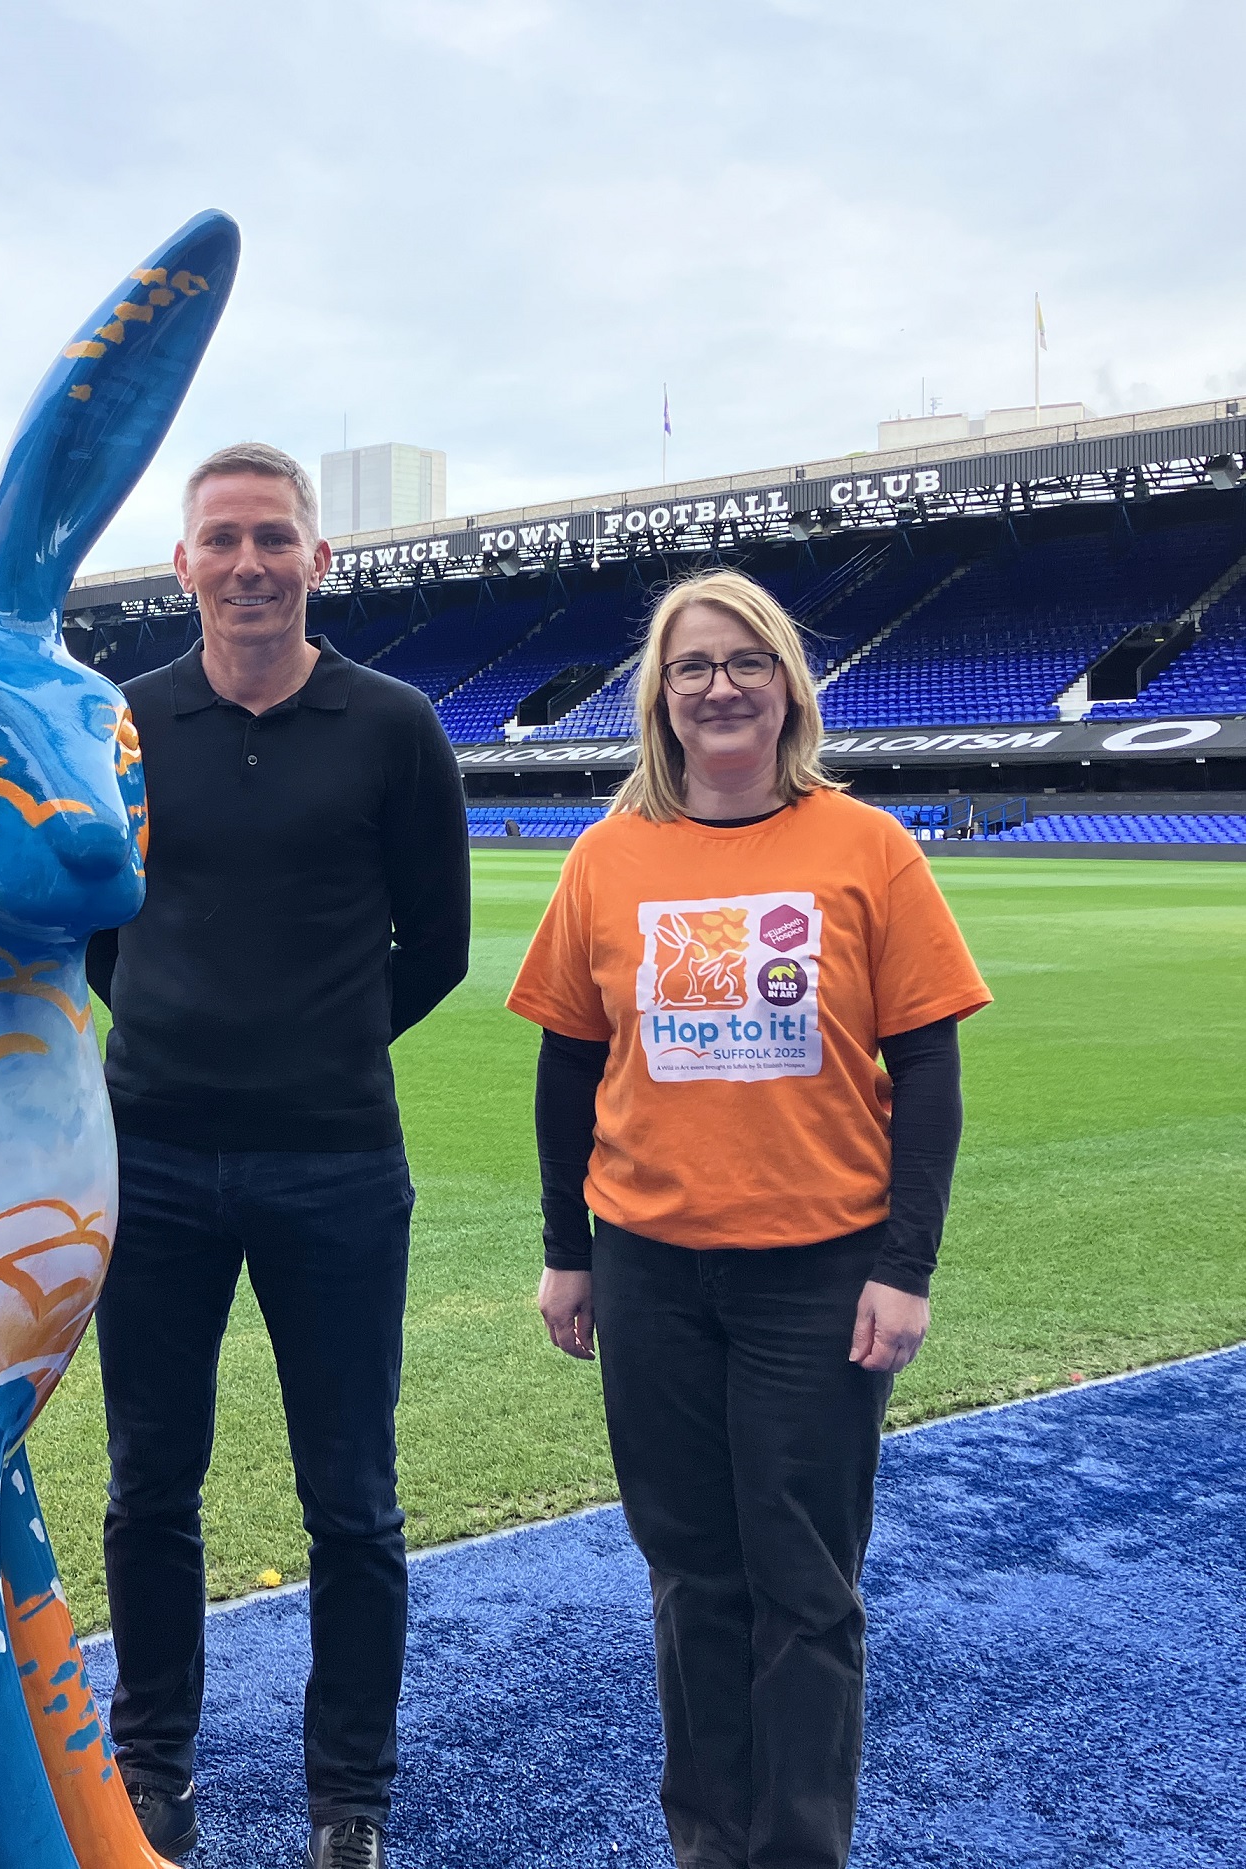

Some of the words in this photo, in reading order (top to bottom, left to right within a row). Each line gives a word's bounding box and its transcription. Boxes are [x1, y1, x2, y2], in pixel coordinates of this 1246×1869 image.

[329, 540, 448, 572] IPSWICH
[480, 522, 569, 551] TOWN
[604, 492, 789, 534] FOOTBALL
[830, 469, 940, 504] CLUB
[818, 731, 1062, 753] ALOITSM
[768, 918, 804, 938] Elizabeth
[770, 926, 804, 944] Hospice
[767, 981, 798, 991] WILD
[767, 990, 778, 998] IN
[653, 1015, 719, 1048] Hop
[727, 1014, 762, 1041] to
[770, 1012, 806, 1041] it!
[713, 1048, 771, 1059] SUFFOLK
[774, 1047, 806, 1058] 2025
